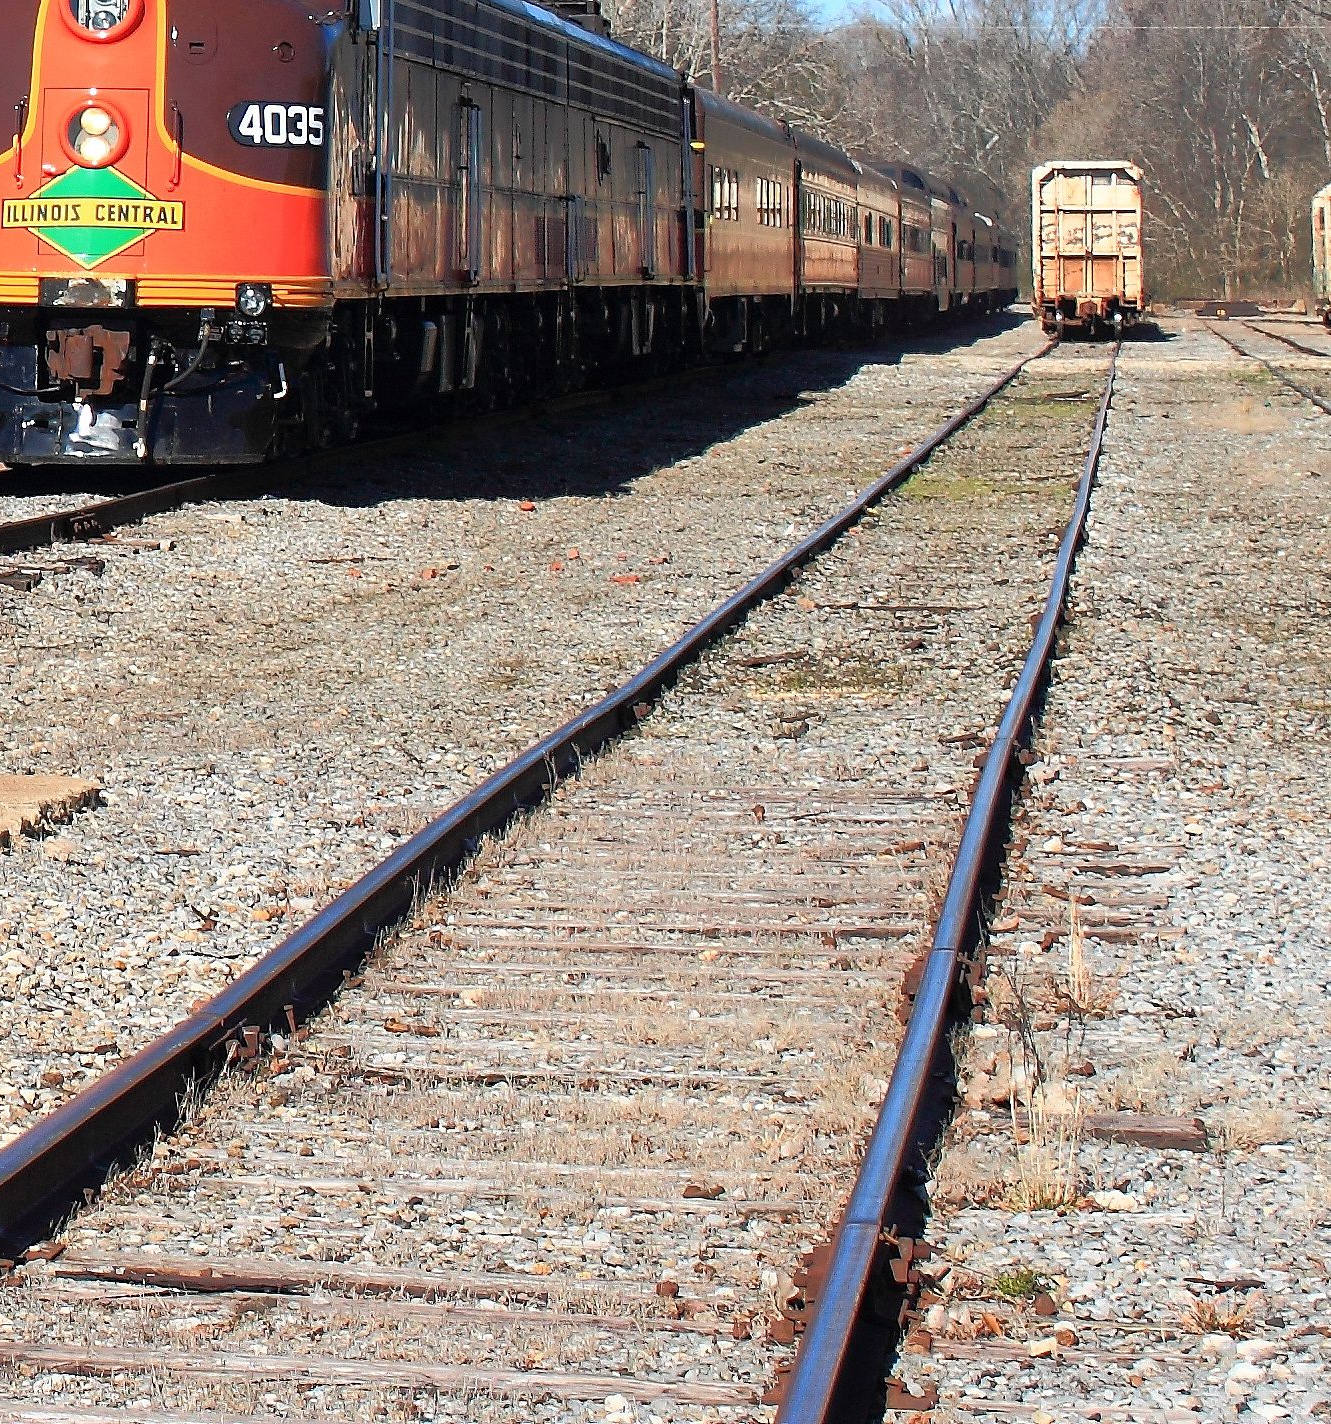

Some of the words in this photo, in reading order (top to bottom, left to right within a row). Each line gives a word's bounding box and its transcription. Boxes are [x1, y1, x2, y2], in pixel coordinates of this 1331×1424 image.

[238, 105, 324, 146] 4035
[6, 204, 81, 223] ILLINOIS
[96, 204, 178, 225] CENTRAL
